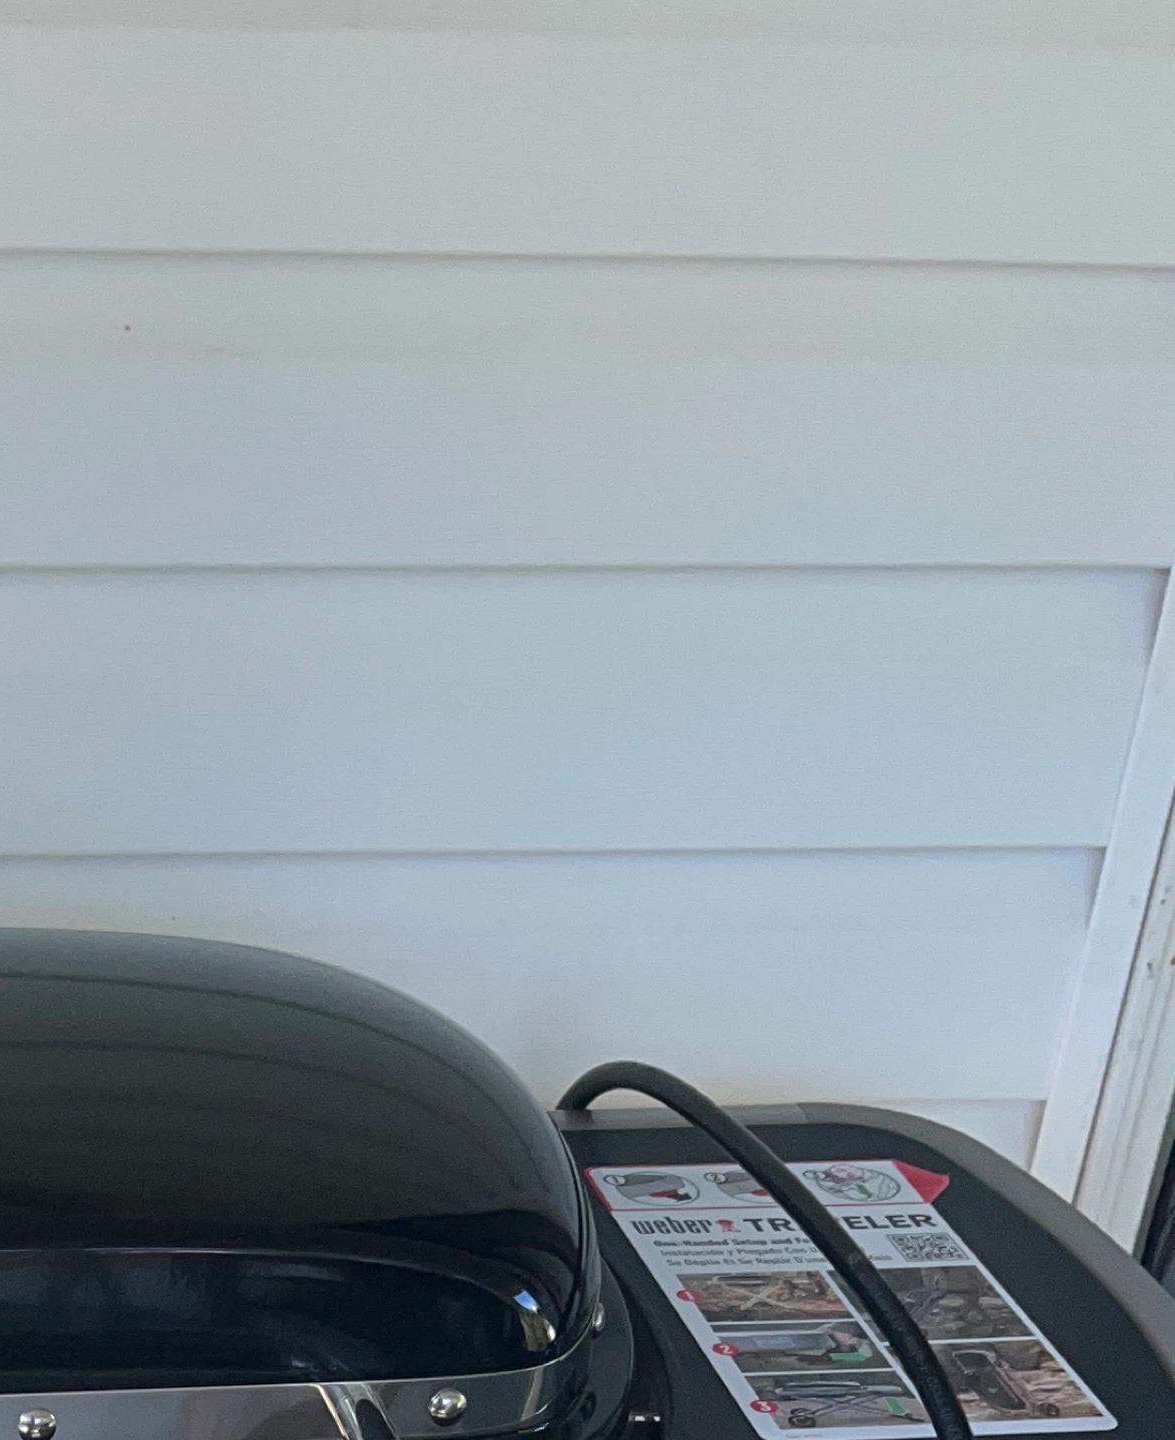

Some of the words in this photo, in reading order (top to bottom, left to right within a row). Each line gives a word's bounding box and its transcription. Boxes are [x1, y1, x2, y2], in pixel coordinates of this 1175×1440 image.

[630, 1216, 712, 1235] weber
[682, 1290, 696, 1300] 1
[718, 1345, 734, 1355] 2
[758, 1401, 772, 1412] 3
